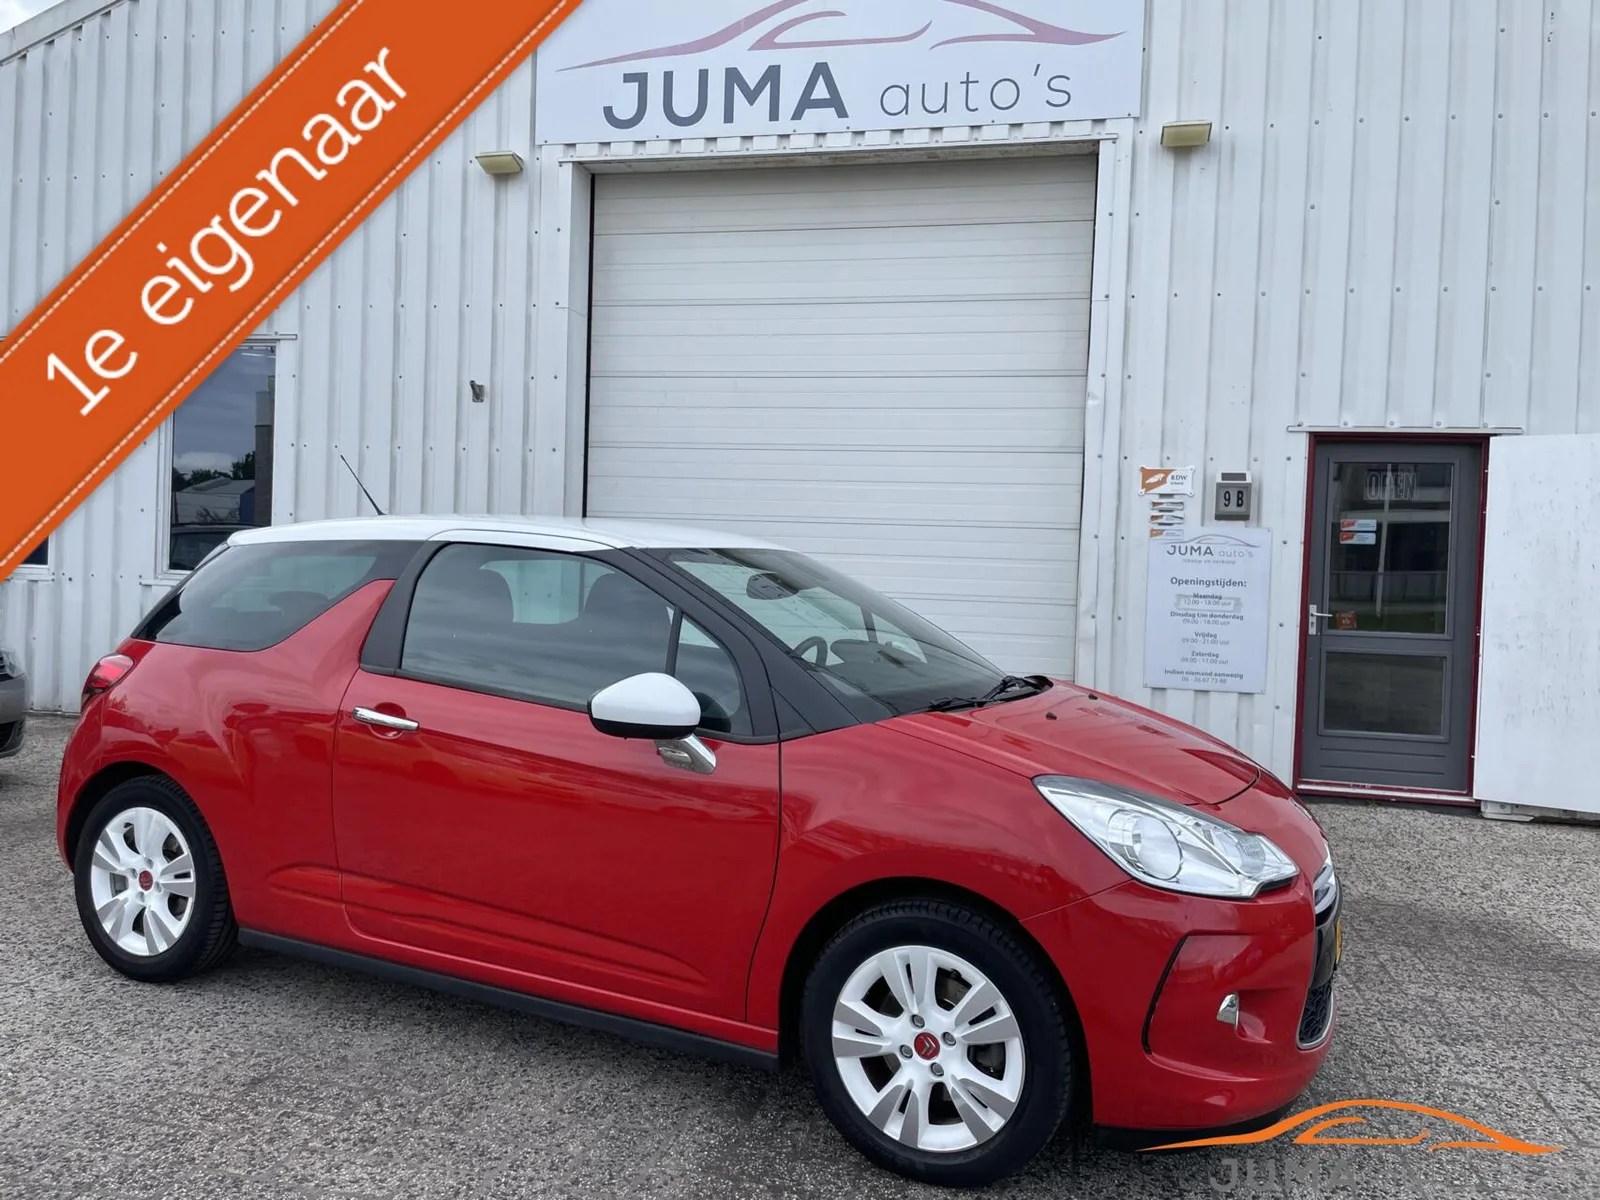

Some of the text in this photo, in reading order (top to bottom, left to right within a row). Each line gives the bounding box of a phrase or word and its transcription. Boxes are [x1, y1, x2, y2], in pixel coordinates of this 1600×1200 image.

[602, 62, 1072, 129] JUMA auto's
[1223, 490, 1244, 508] 9 B
[1166, 545, 1253, 558] JUMA auto's
[1170, 576, 1247, 588] Openingstijden:
